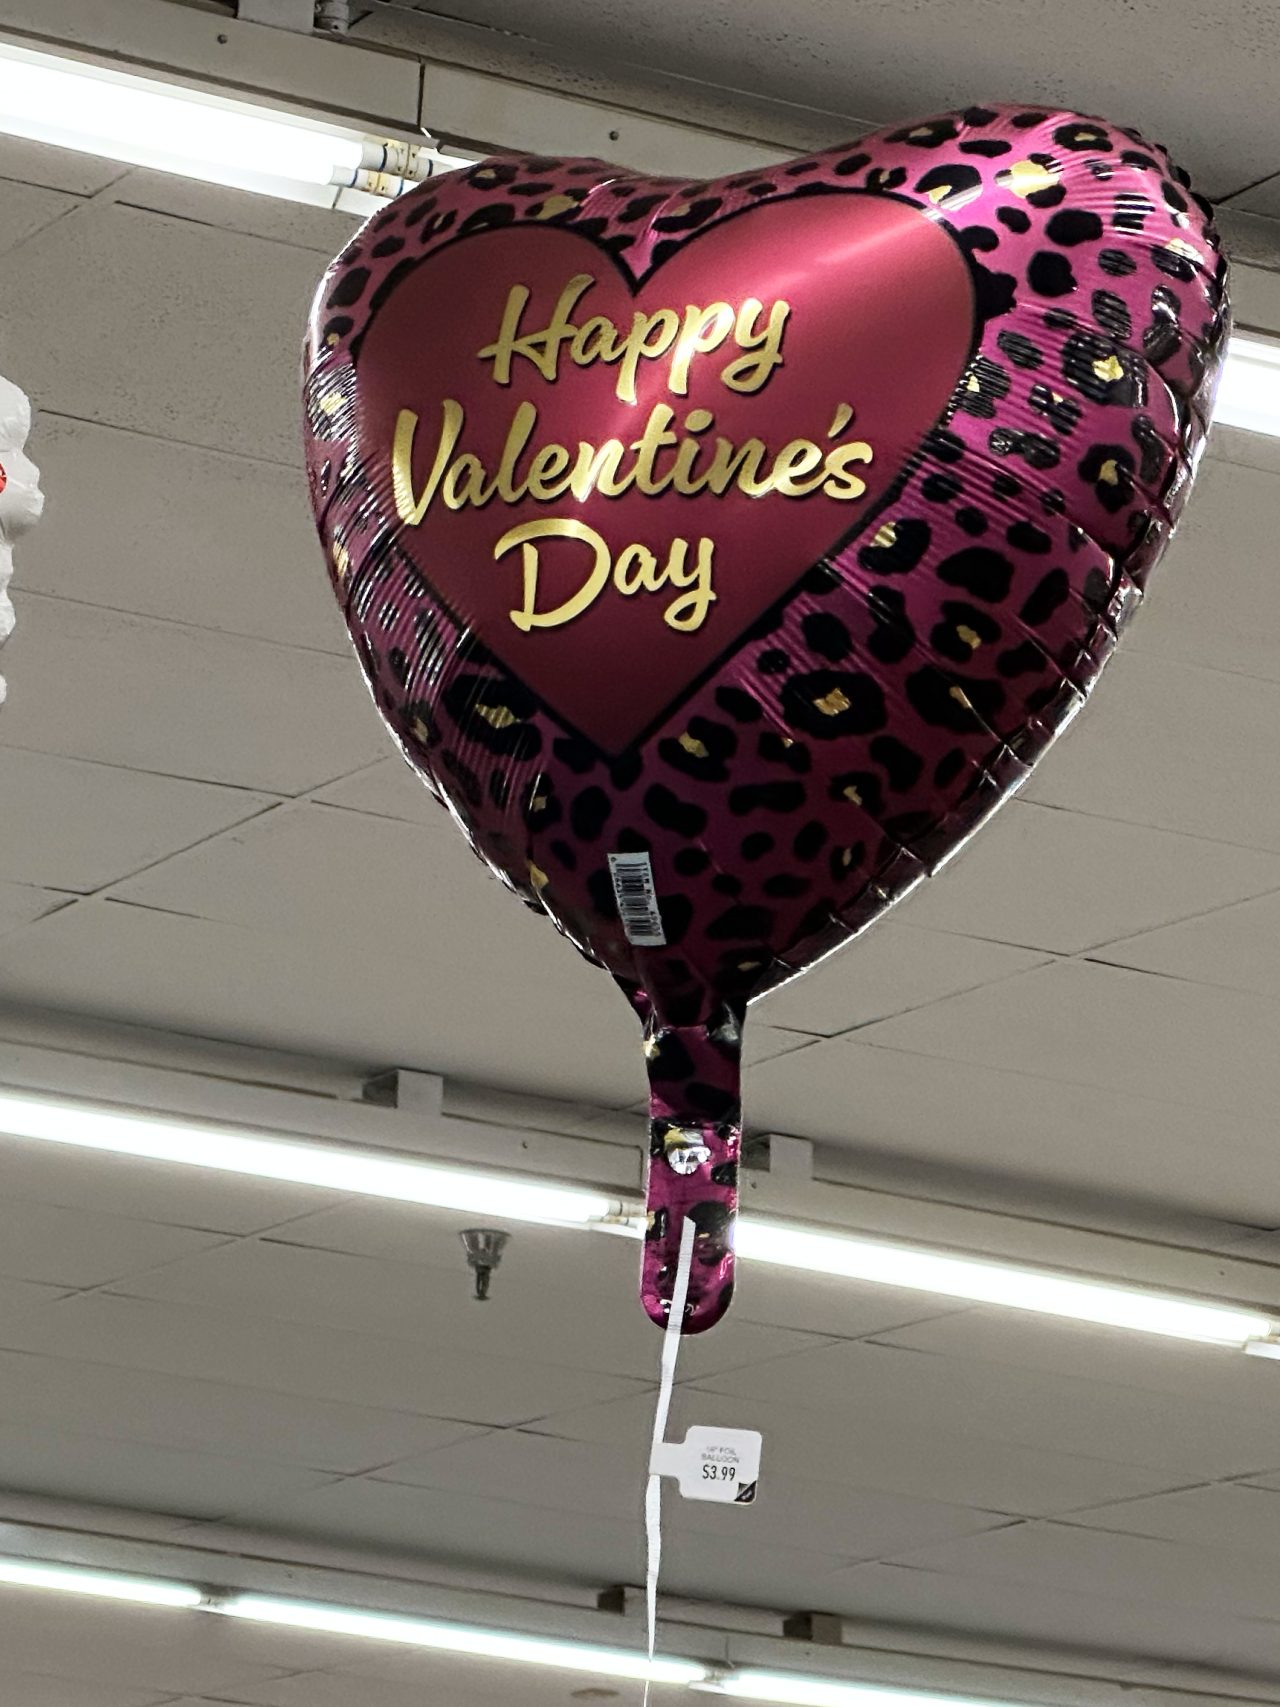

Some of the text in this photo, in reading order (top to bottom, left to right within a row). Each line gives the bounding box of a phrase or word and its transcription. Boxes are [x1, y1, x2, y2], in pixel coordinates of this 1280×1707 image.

[477, 273, 791, 405] Happy
[391, 398, 874, 526] Valentine's
[494, 517, 718, 632] Day
[702, 1464, 736, 1481] $3.99
